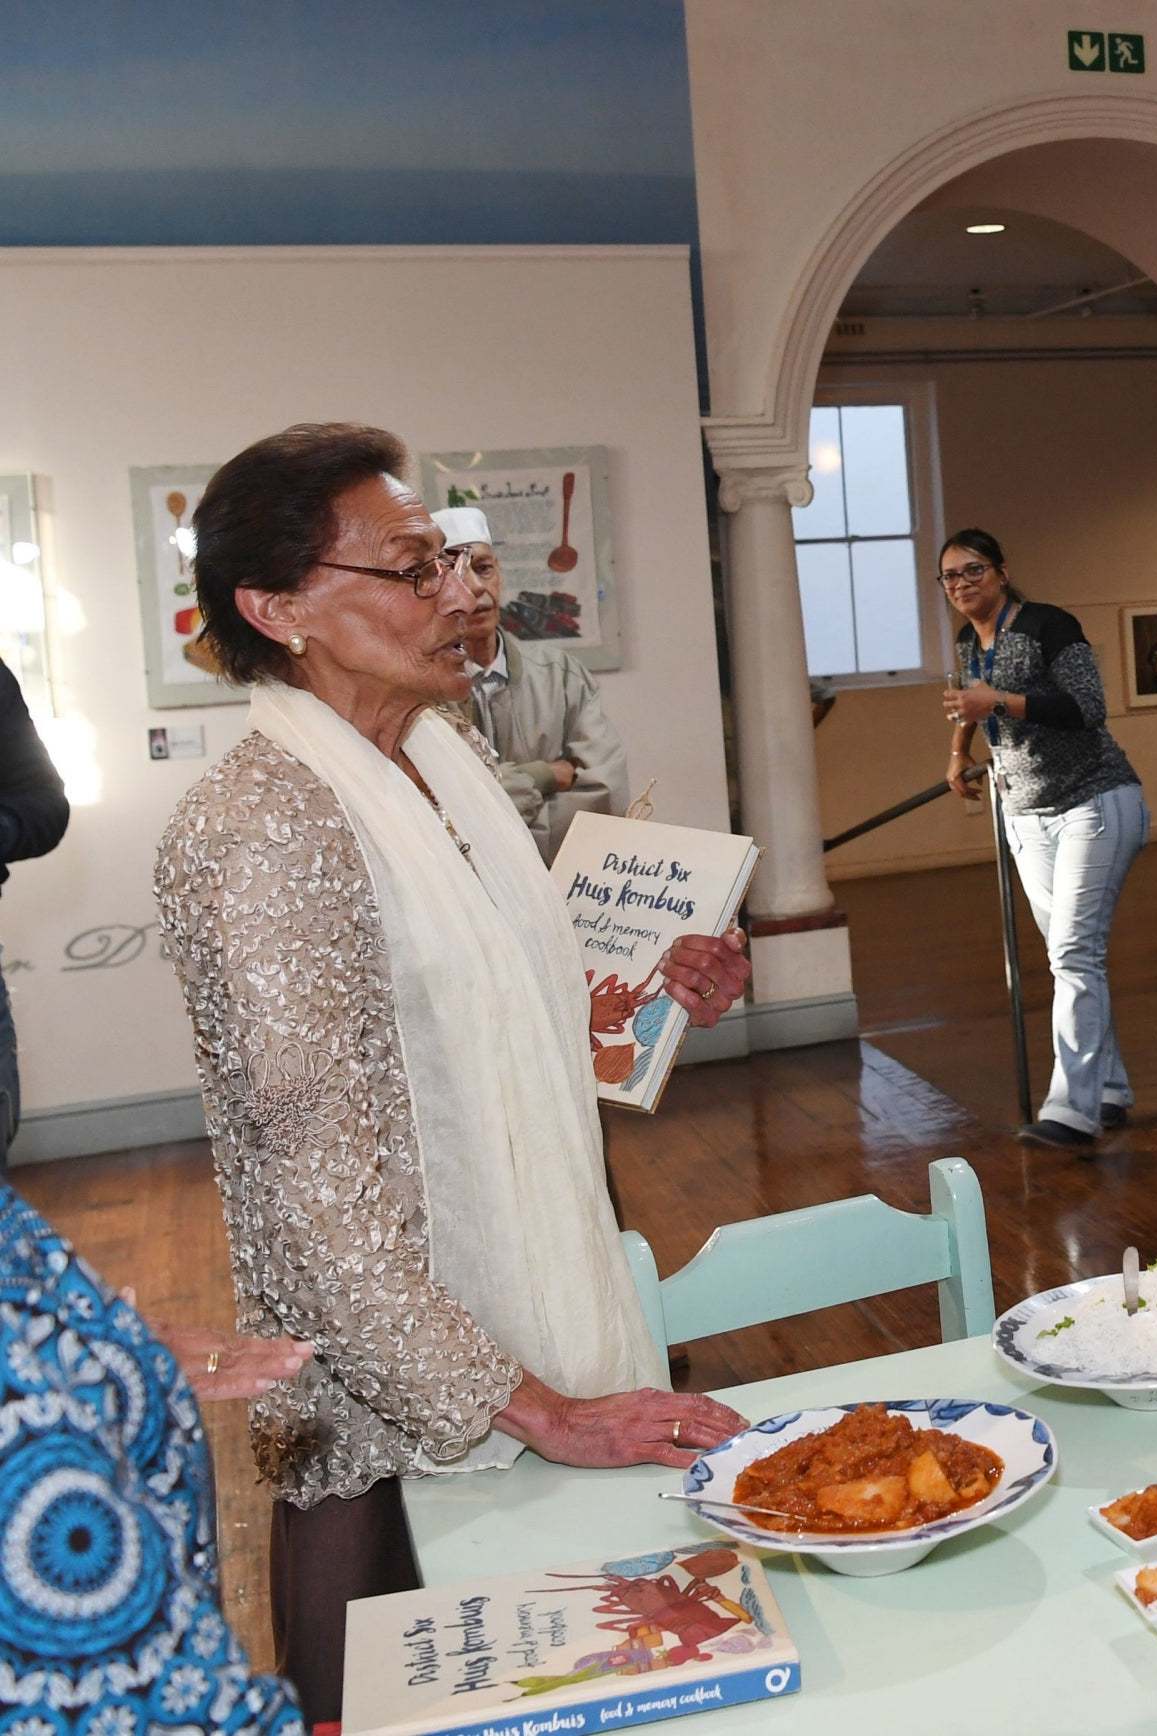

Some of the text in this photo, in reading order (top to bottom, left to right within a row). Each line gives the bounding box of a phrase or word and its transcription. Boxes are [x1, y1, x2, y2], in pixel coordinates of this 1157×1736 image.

[603, 853, 692, 882] District Six
[567, 872, 612, 906] Huis
[585, 935, 637, 961] cookbook
[613, 922, 661, 945] memory
[517, 1602, 537, 1639] memory
[537, 1607, 568, 1647] cookbook
[400, 1617, 441, 1686] District Six
[450, 1656, 498, 1696] Huis
[600, 1702, 623, 1724] food
[637, 1696, 677, 1713] memory
[679, 1684, 724, 1705] cookbook
